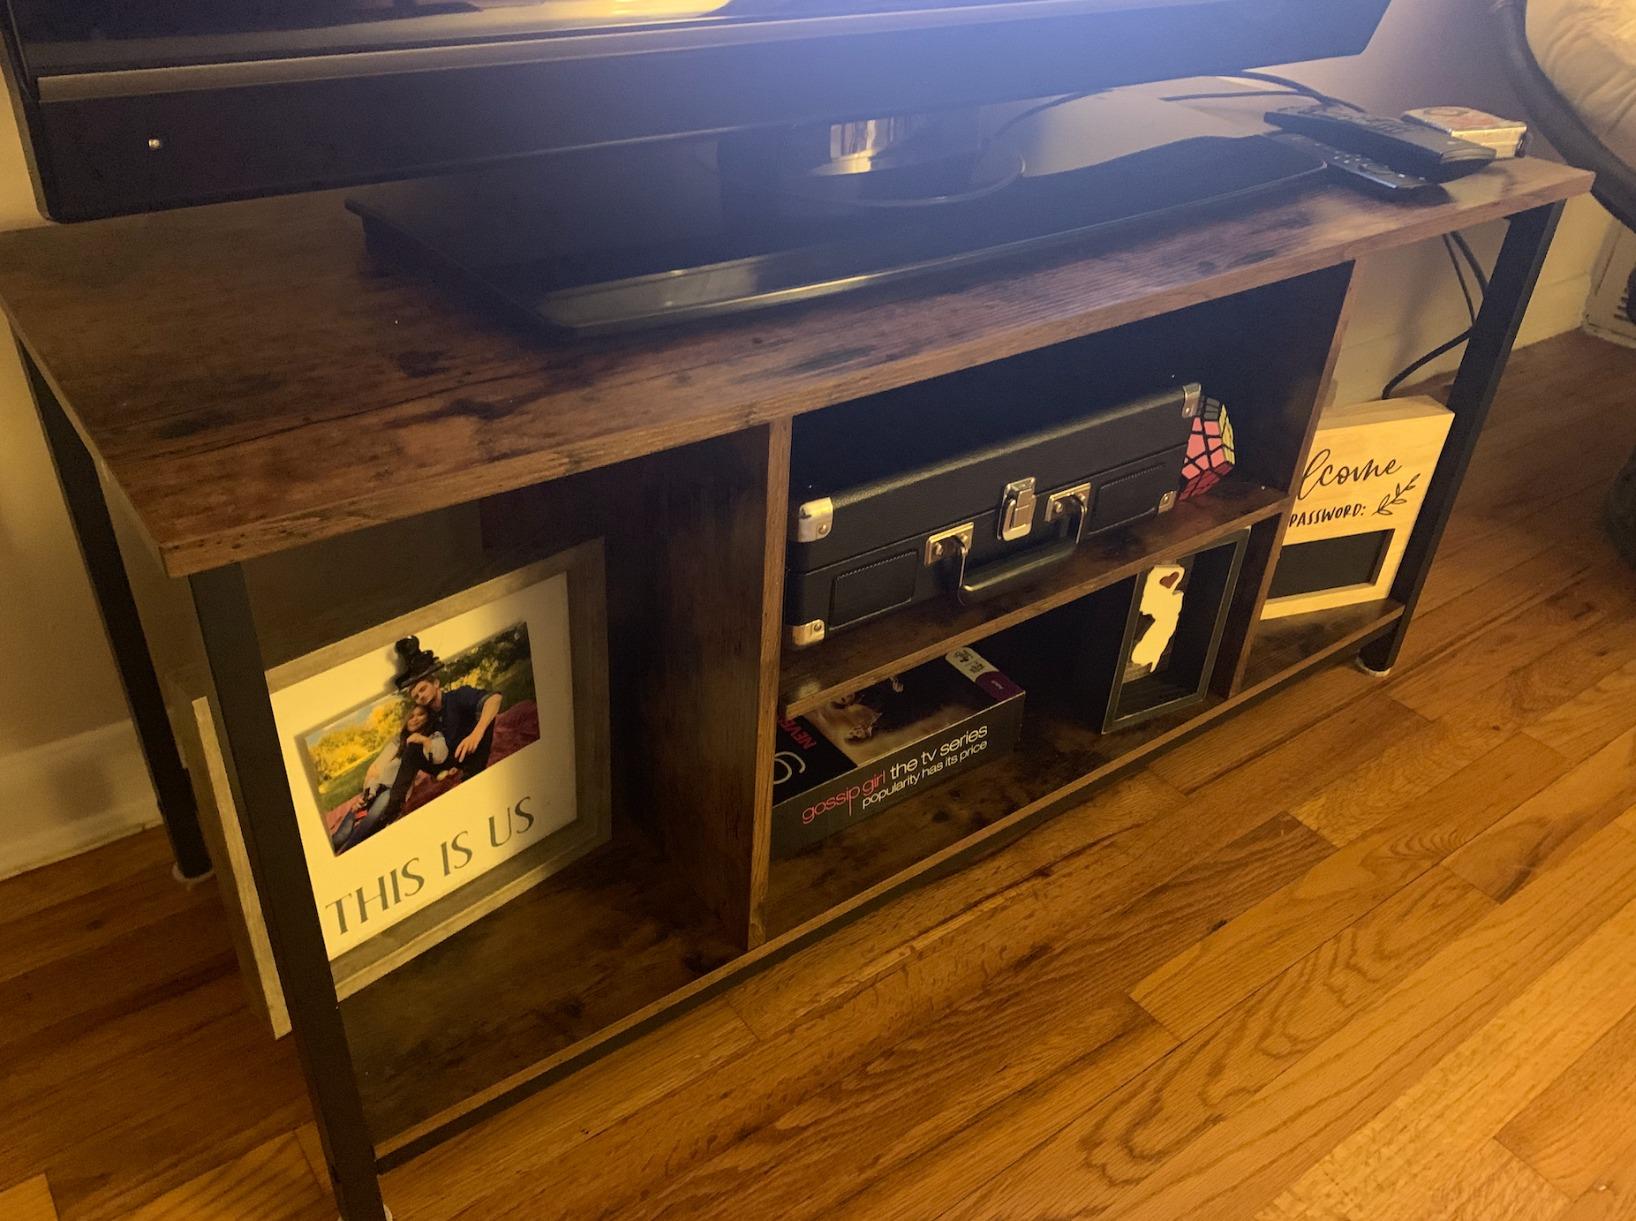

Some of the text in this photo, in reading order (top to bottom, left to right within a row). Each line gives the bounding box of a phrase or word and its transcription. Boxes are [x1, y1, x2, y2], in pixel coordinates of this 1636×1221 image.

[1297, 448, 1402, 501] lcome
[1288, 502, 1367, 528] PASSWORD:
[801, 724, 989, 825] gossip girl the tv series
[862, 739, 989, 810] popularity has its price
[324, 795, 535, 936] THIS IS US
